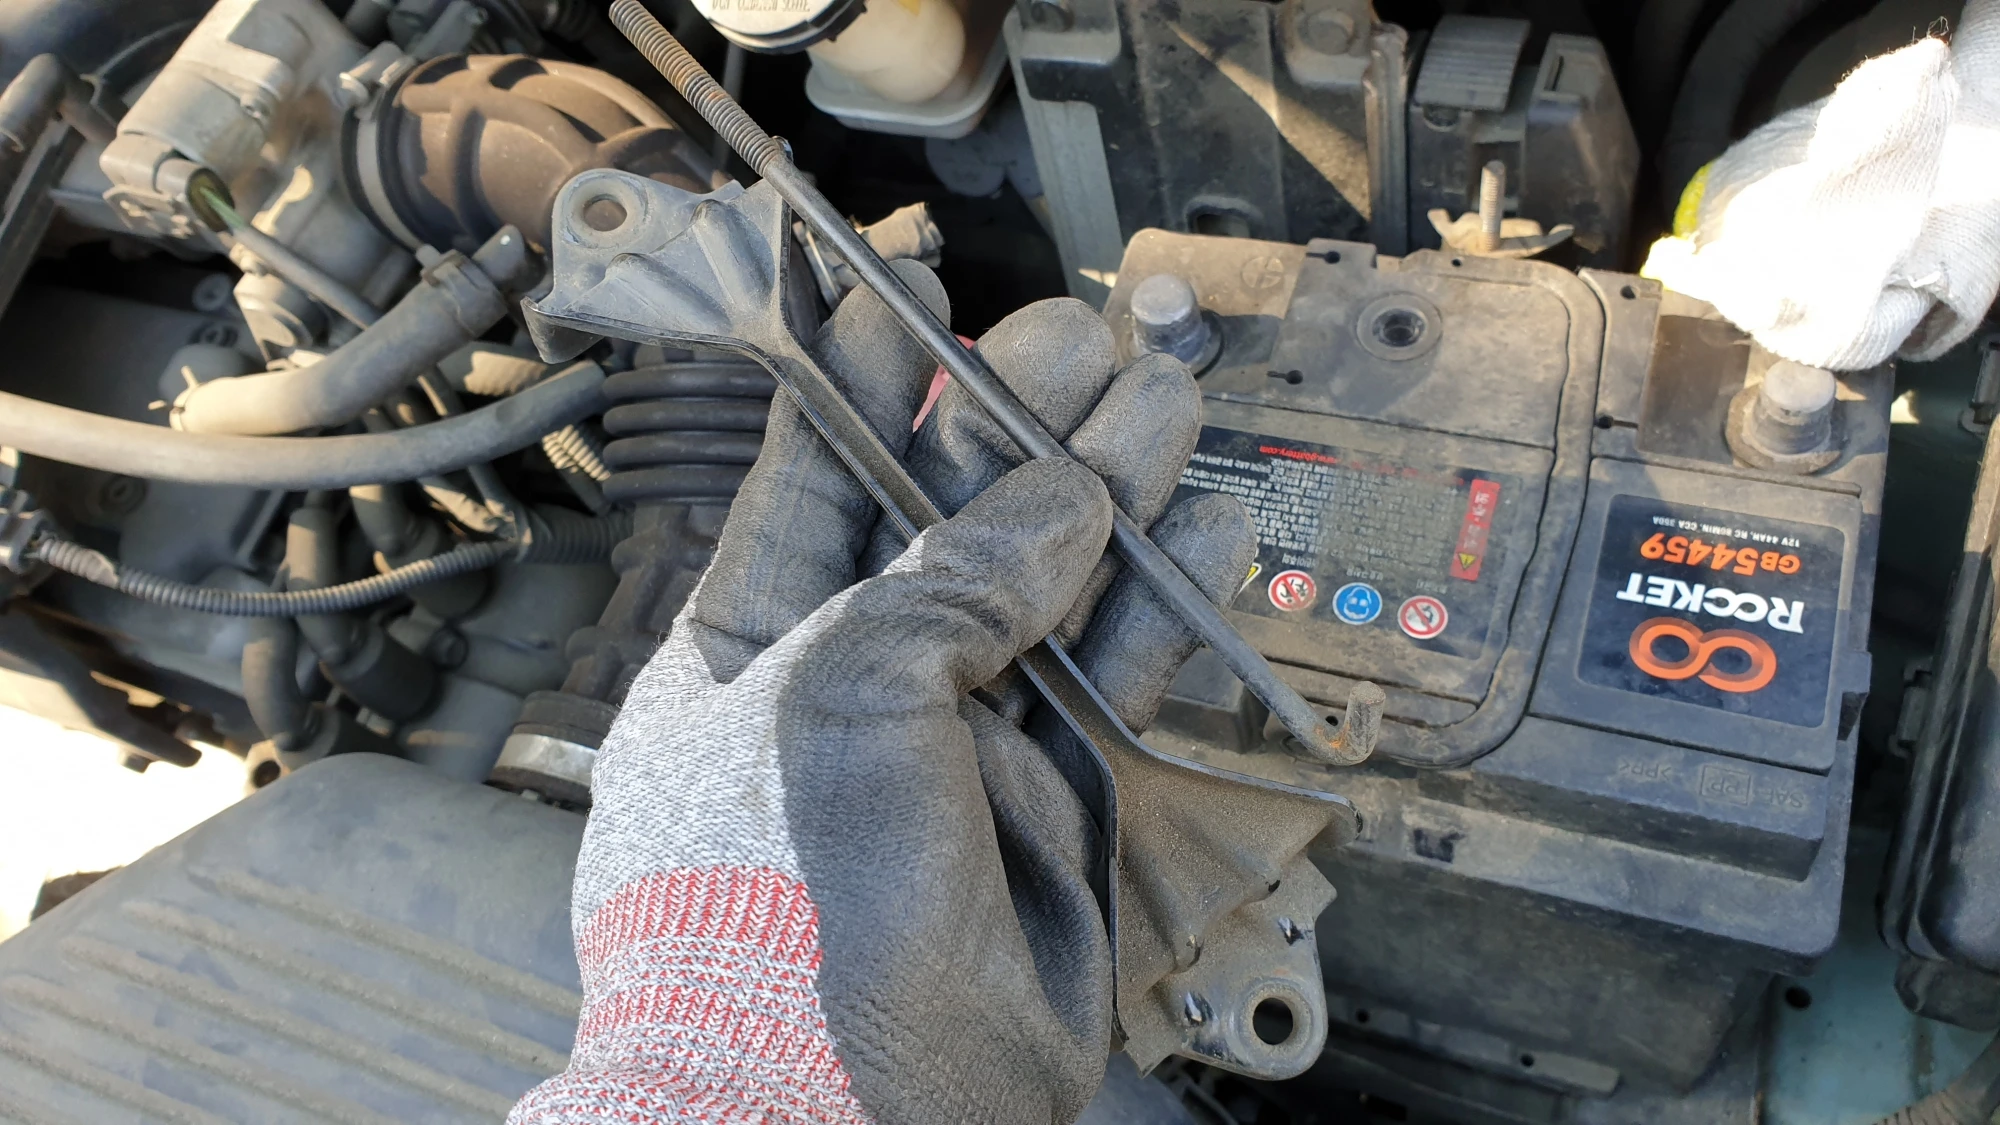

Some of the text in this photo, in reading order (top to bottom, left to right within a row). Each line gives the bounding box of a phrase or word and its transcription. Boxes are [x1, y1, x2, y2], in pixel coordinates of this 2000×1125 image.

[1678, 519, 1698, 532] CCA
[1733, 530, 1749, 540] RC
[1781, 538, 1800, 548] 12V
[1640, 533, 1801, 576] GB54459
[1616, 572, 1805, 634] ROCKET
